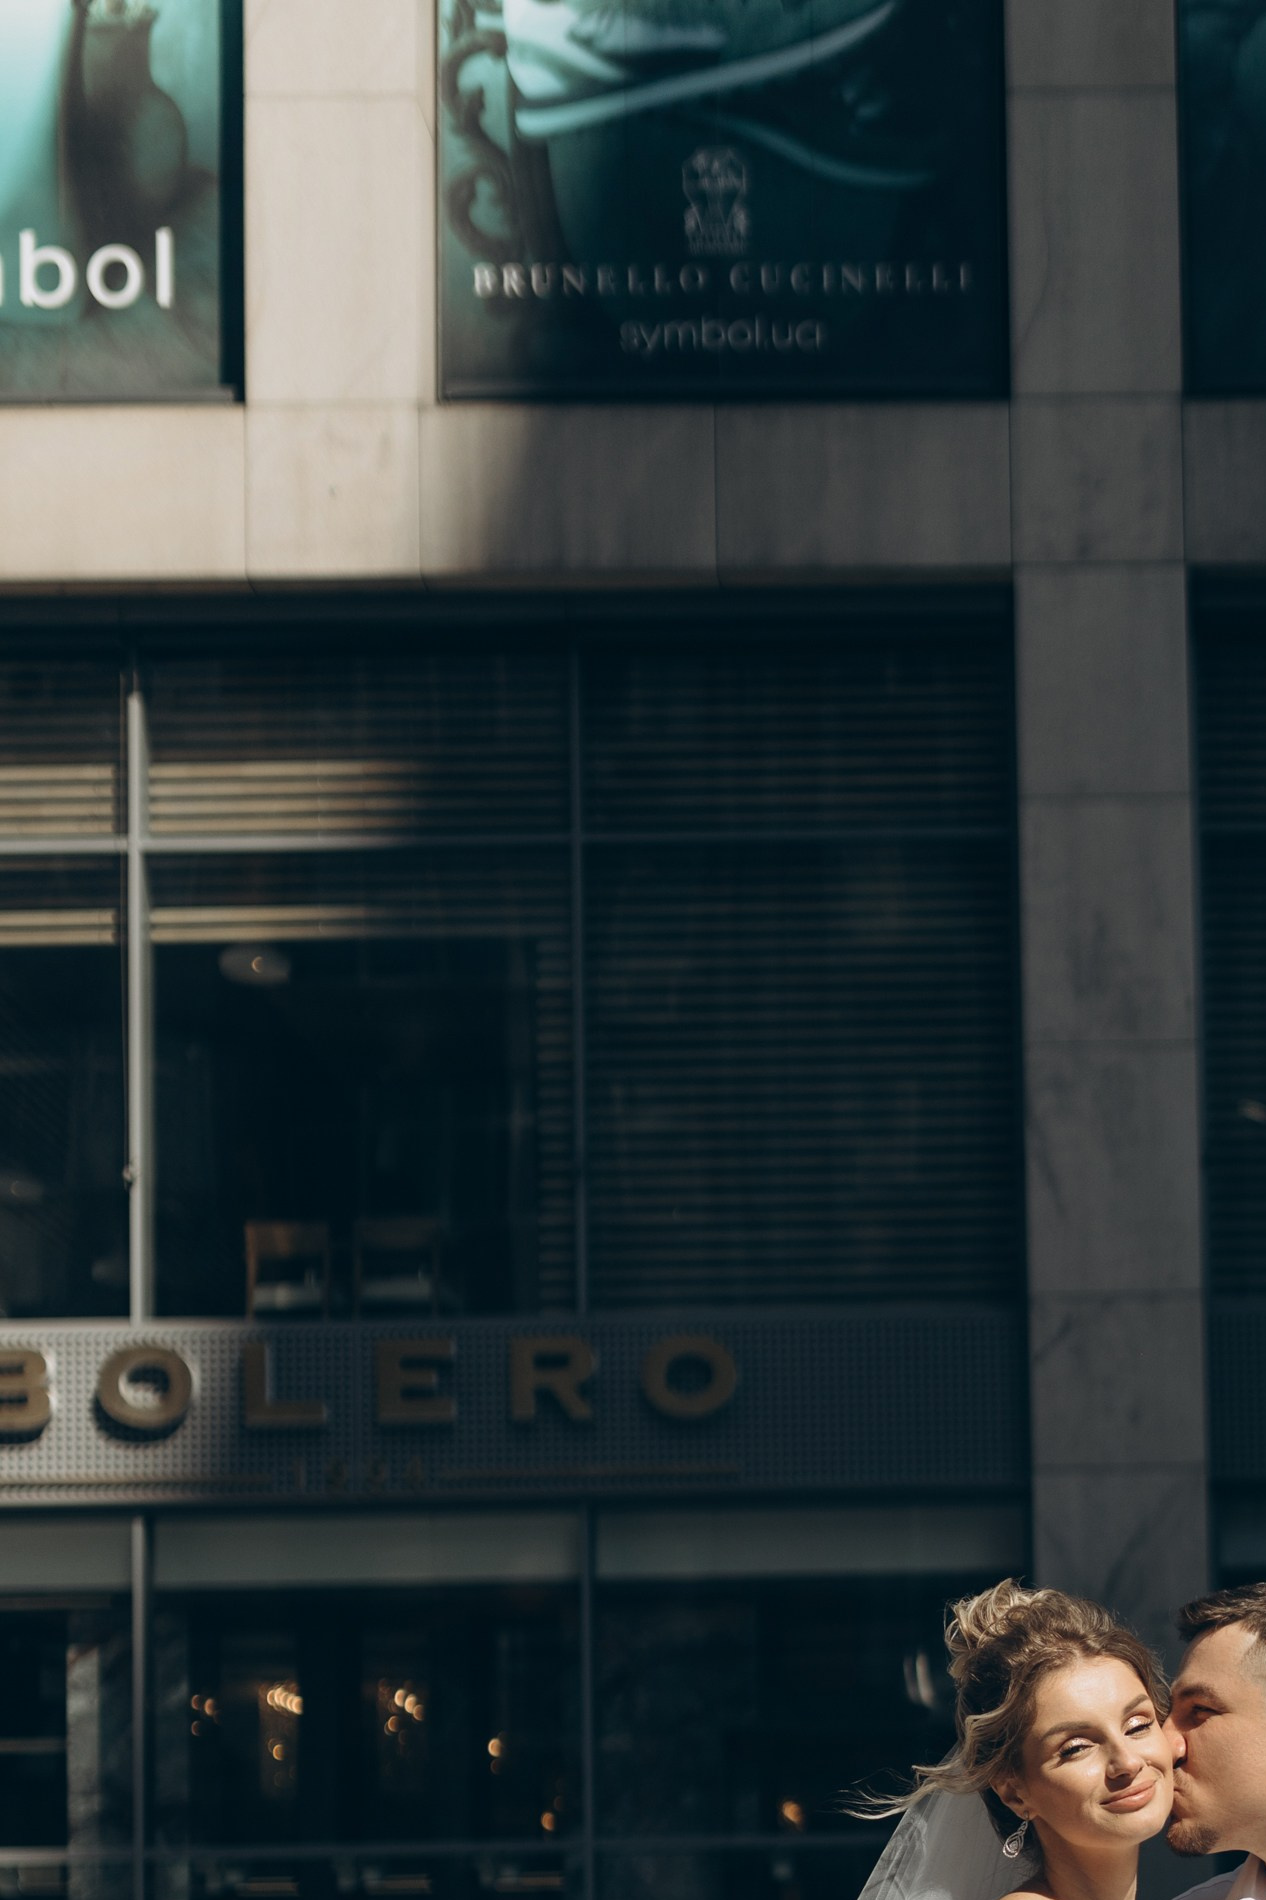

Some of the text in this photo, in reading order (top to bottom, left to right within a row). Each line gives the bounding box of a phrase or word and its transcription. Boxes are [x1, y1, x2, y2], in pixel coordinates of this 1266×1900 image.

[0, 226, 175, 310] bol
[473, 258, 976, 299] BRUNELLO CUCINELLI
[618, 313, 829, 359] symbol.ua
[0, 1334, 738, 1436] BOLERO
